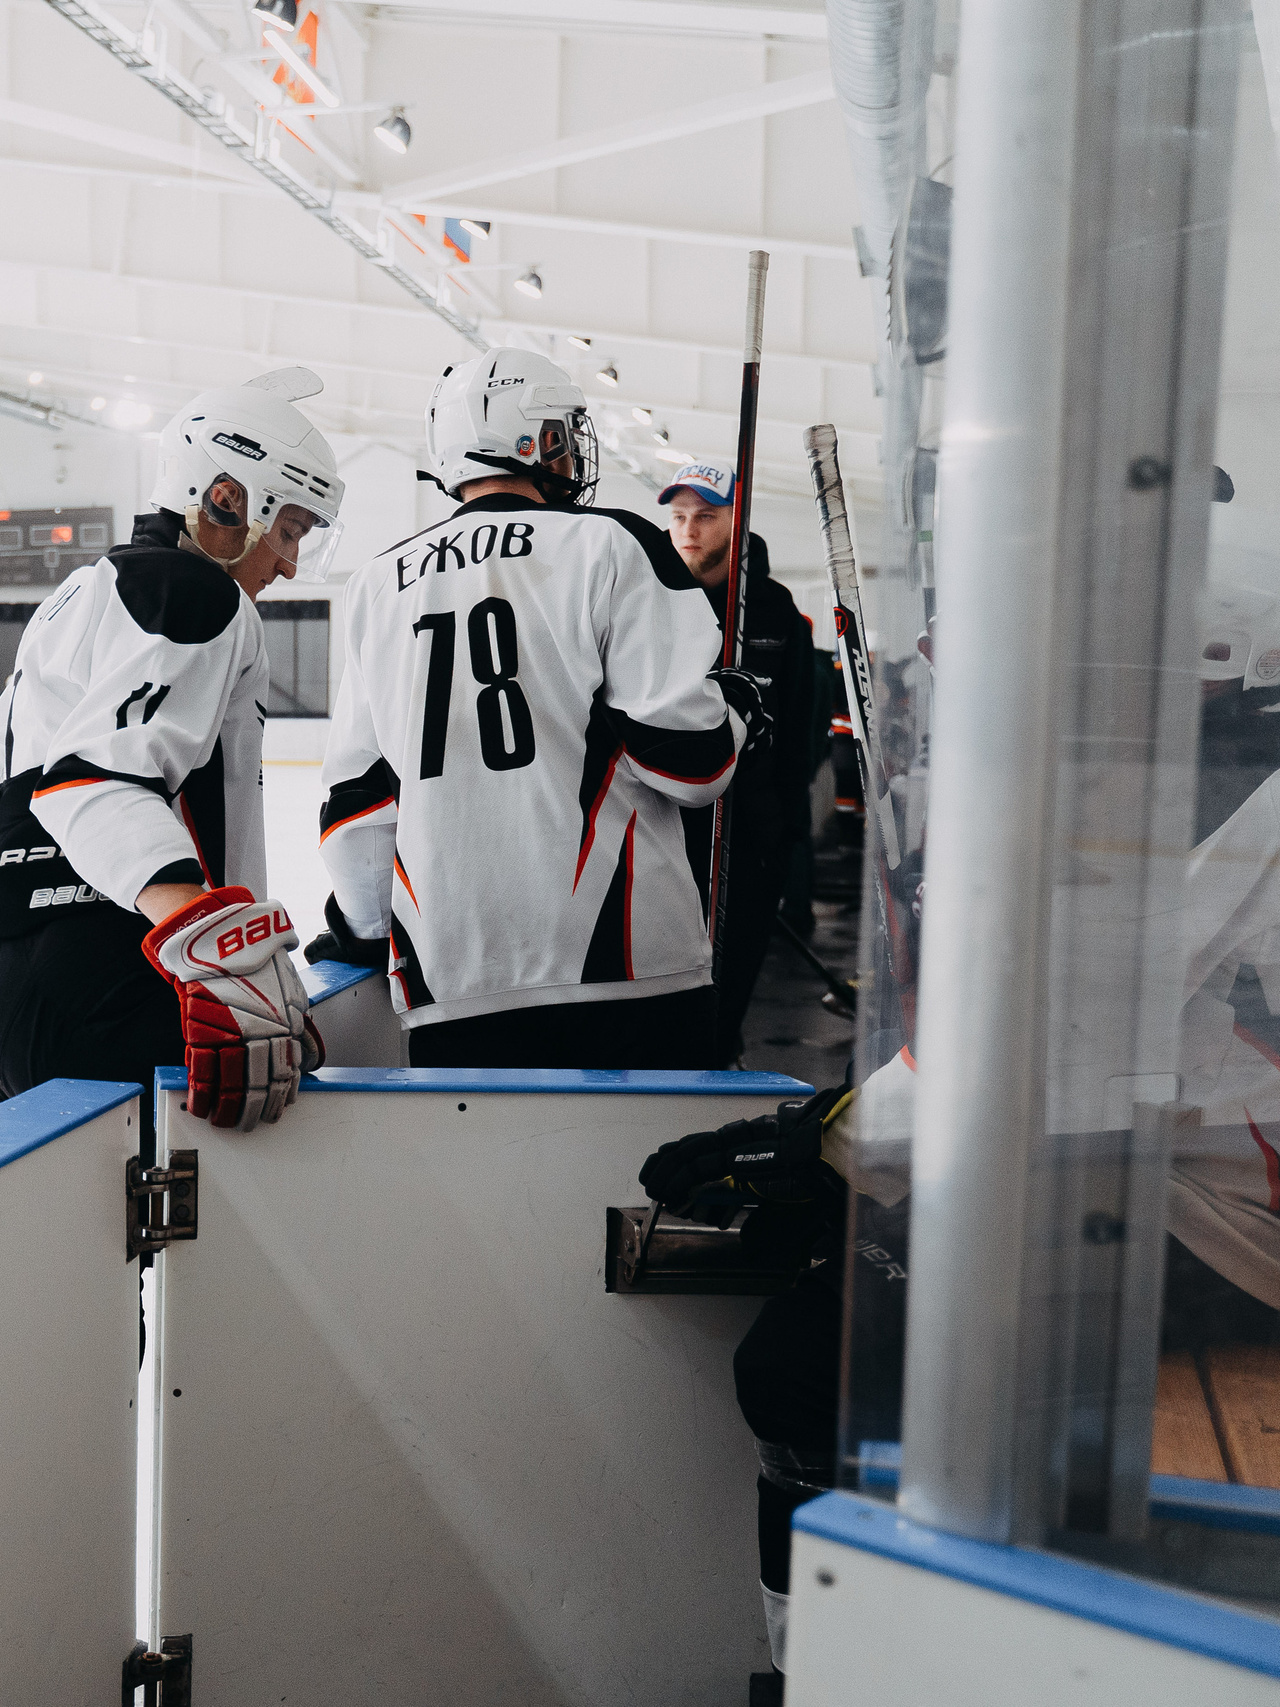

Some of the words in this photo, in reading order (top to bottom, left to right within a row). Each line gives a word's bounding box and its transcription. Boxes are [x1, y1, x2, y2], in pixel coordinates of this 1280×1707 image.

[487, 378, 525, 388] CCM
[215, 435, 263, 459] BAUER
[397, 522, 535, 593] ЕЖОВ
[412, 596, 536, 779] 78
[734, 1152, 775, 1162] BAUER
